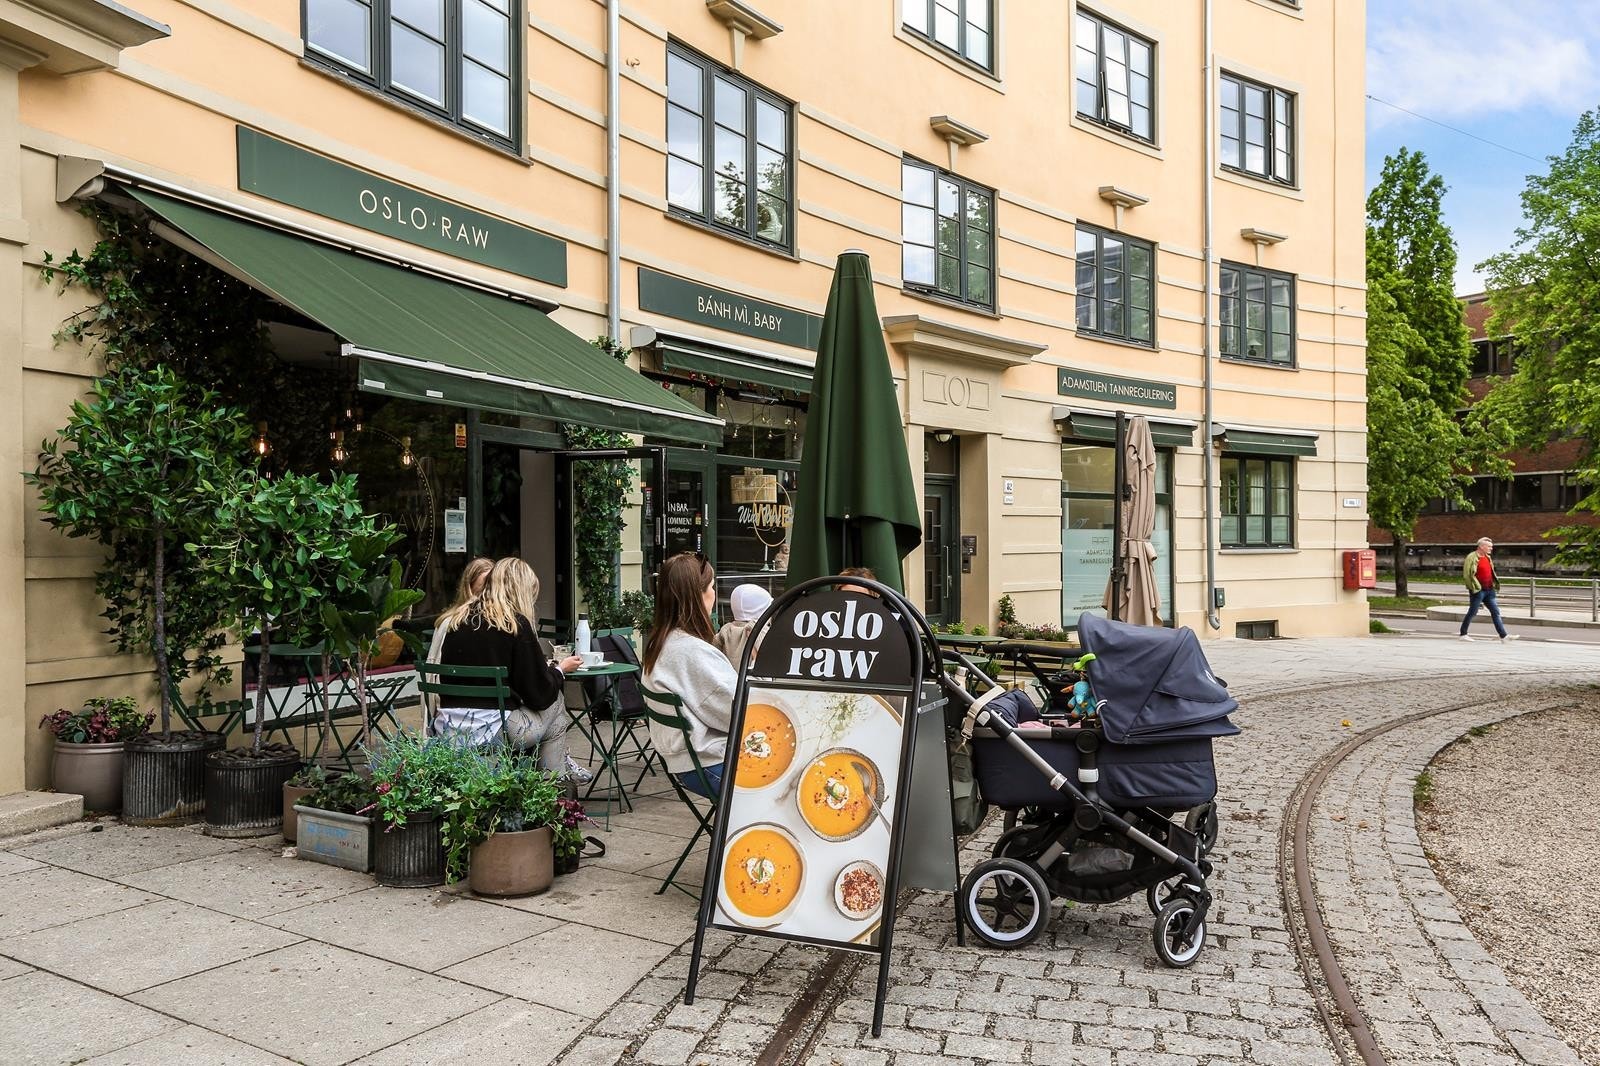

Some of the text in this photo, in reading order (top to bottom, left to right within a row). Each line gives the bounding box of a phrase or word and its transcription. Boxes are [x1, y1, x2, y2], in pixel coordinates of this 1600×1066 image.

[697, 295, 731, 319] BÁNH
[754, 312, 783, 332] BABY
[1062, 376, 1174, 402] ADAMSTUEN TANNREGULERING
[793, 600, 884, 641] oslo
[786, 647, 880, 680] raw
